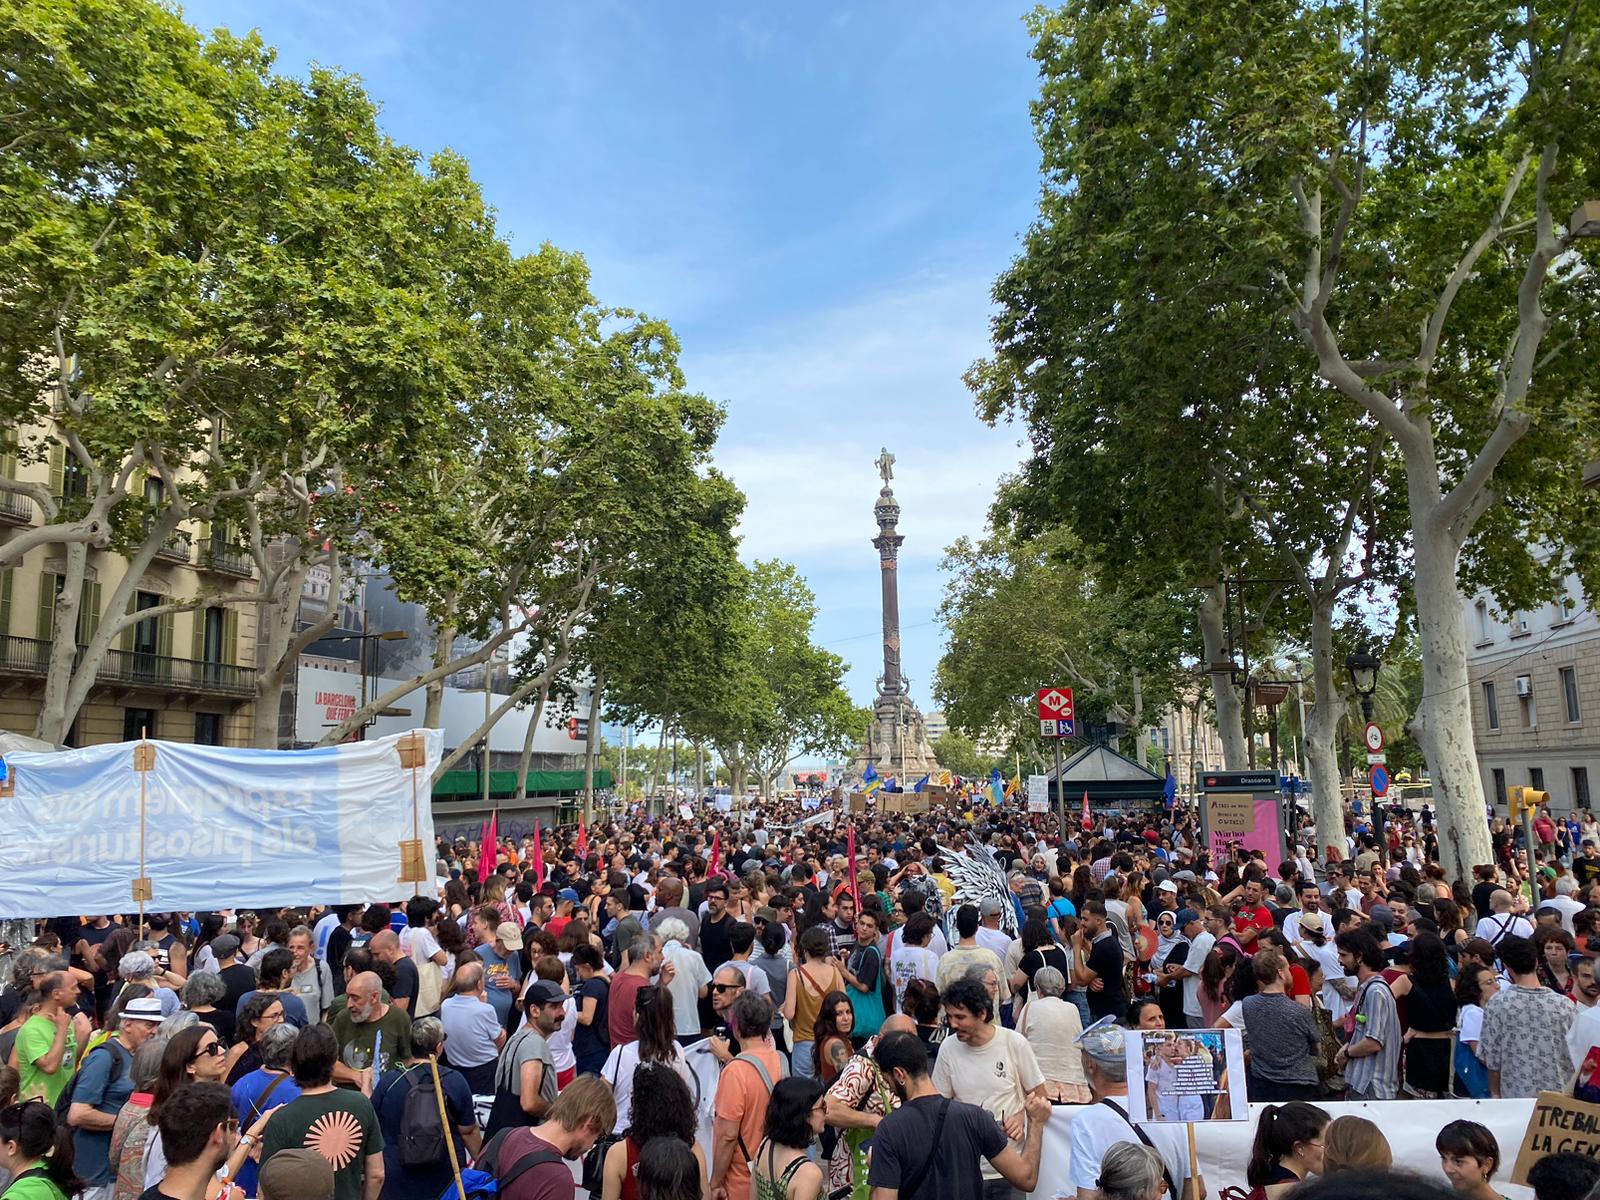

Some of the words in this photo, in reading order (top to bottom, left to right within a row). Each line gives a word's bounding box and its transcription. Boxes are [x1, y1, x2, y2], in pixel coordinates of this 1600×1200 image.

[316, 691, 322, 705] LA
[1048, 696, 1060, 706] M
[326, 706, 337, 720] QUE
[1531, 1134, 1552, 1152] LA
